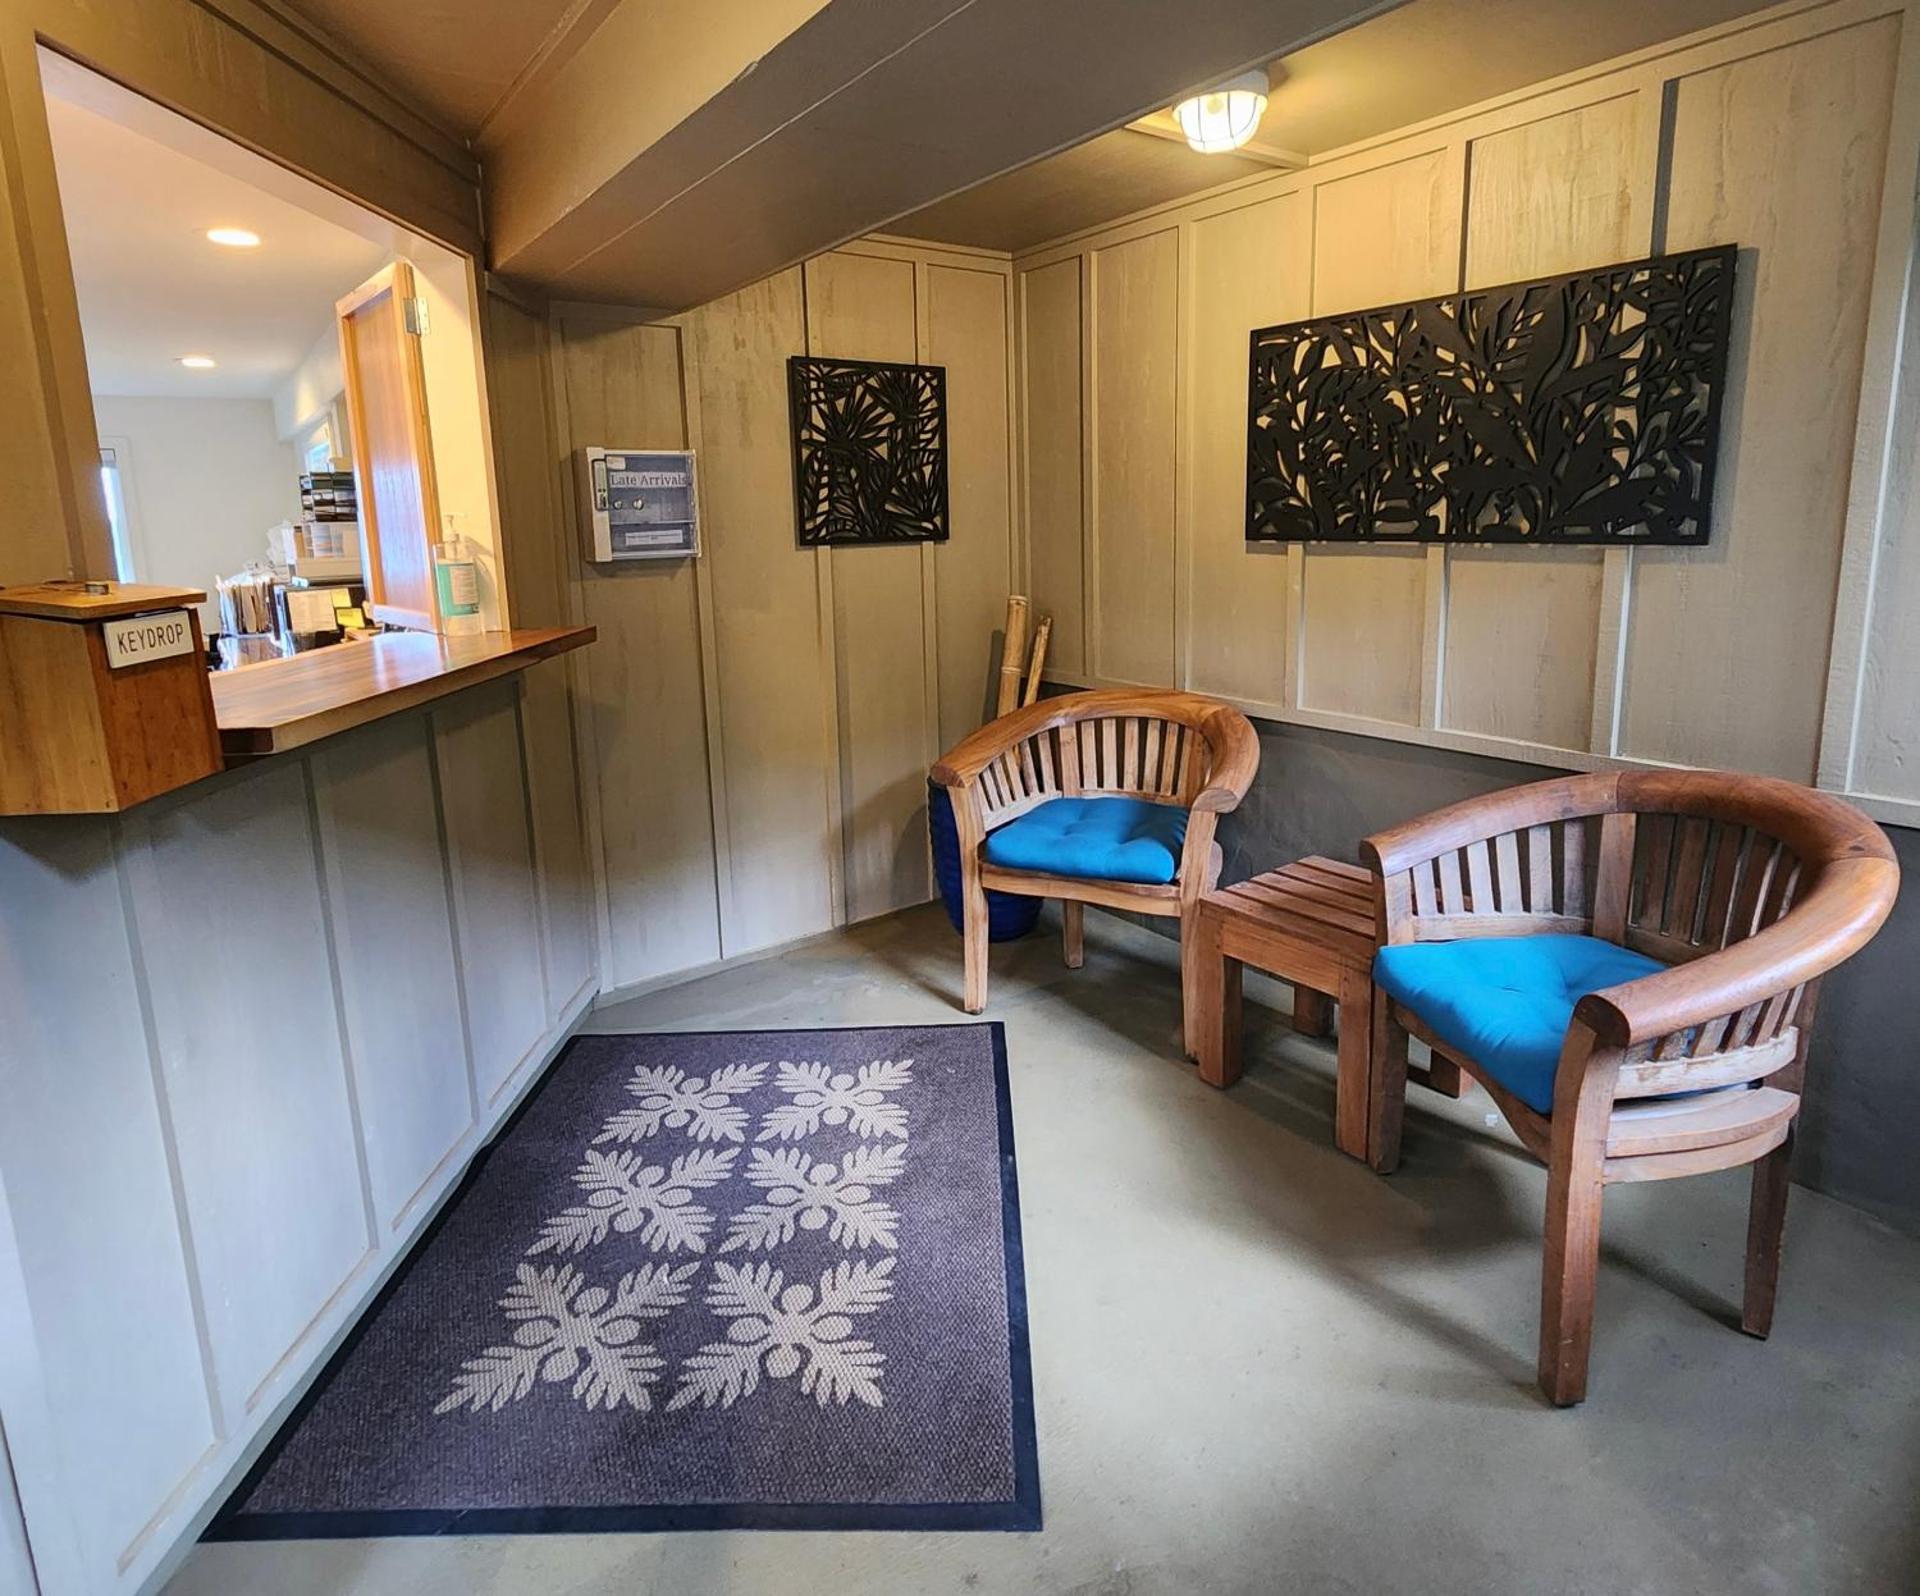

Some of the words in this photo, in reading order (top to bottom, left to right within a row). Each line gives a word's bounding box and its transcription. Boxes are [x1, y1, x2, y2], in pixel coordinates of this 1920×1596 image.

[611, 474, 636, 486] Late
[640, 473, 687, 486] Arrivals
[117, 623, 184, 655] KEYDROP
